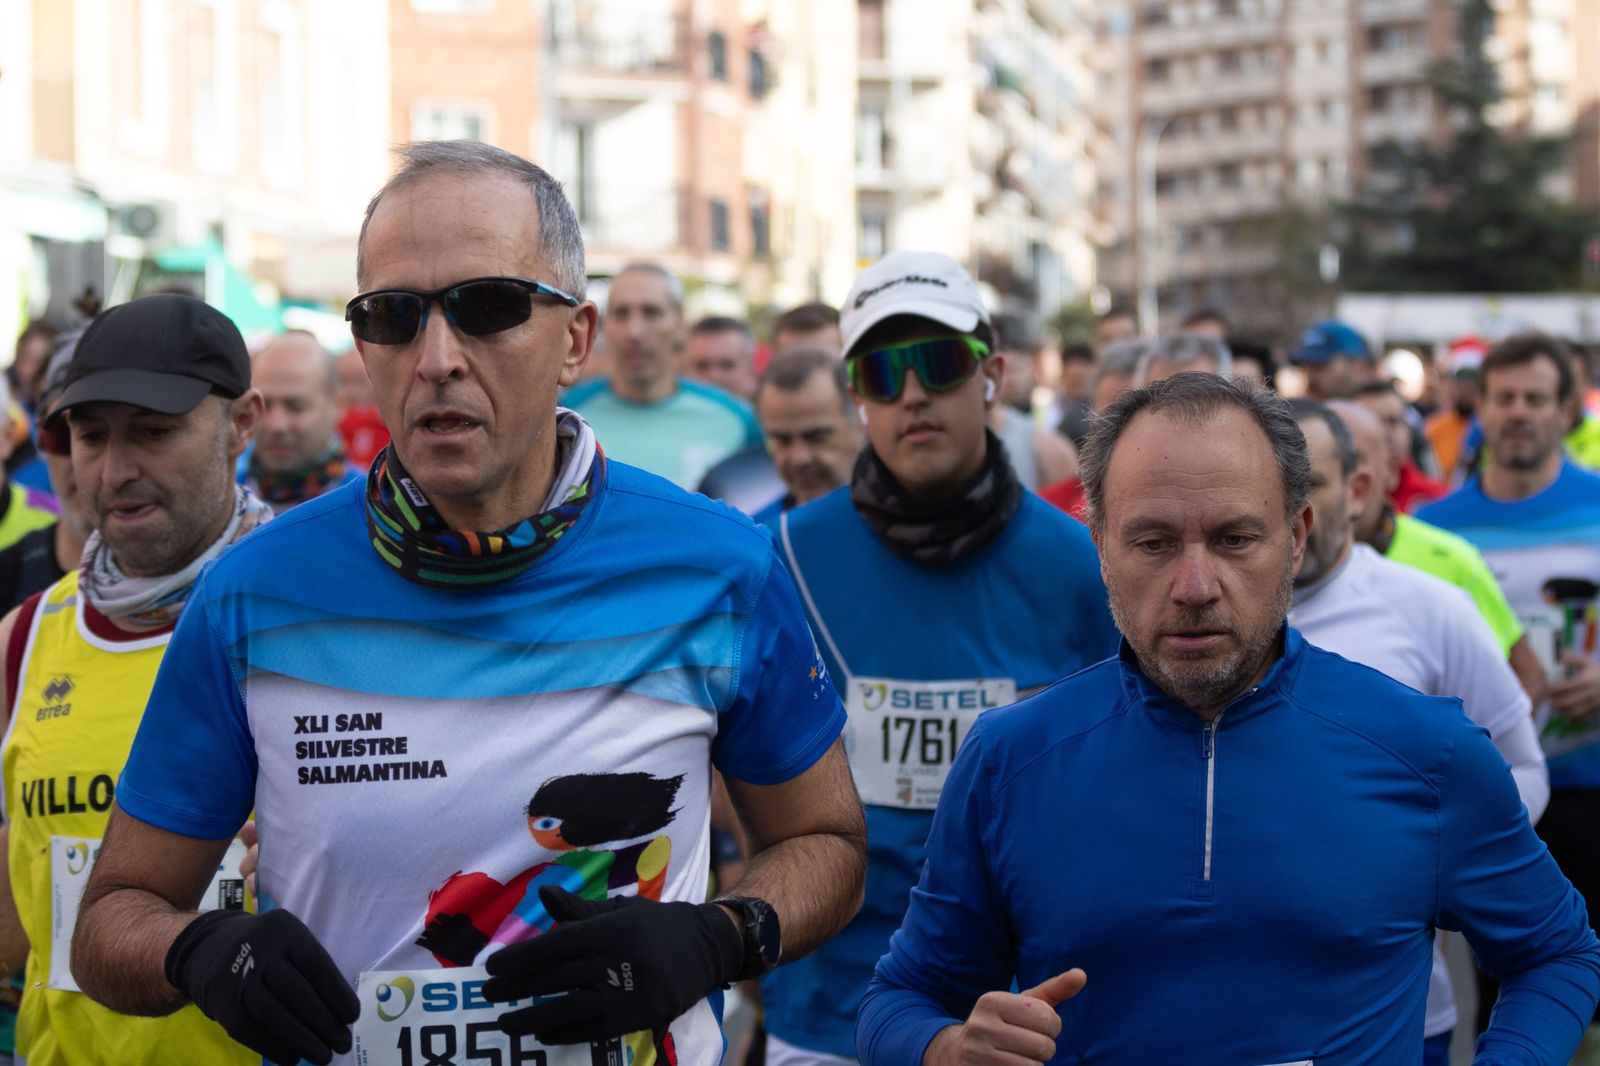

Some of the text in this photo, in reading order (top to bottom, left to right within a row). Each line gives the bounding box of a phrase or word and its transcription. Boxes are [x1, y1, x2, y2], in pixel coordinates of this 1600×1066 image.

[891, 689, 997, 710] SETEL
[293, 712, 382, 734] XLI SAN
[295, 737, 408, 759] SILVESTRE
[881, 716, 958, 765] 1761
[297, 760, 448, 785] SALMANTINA
